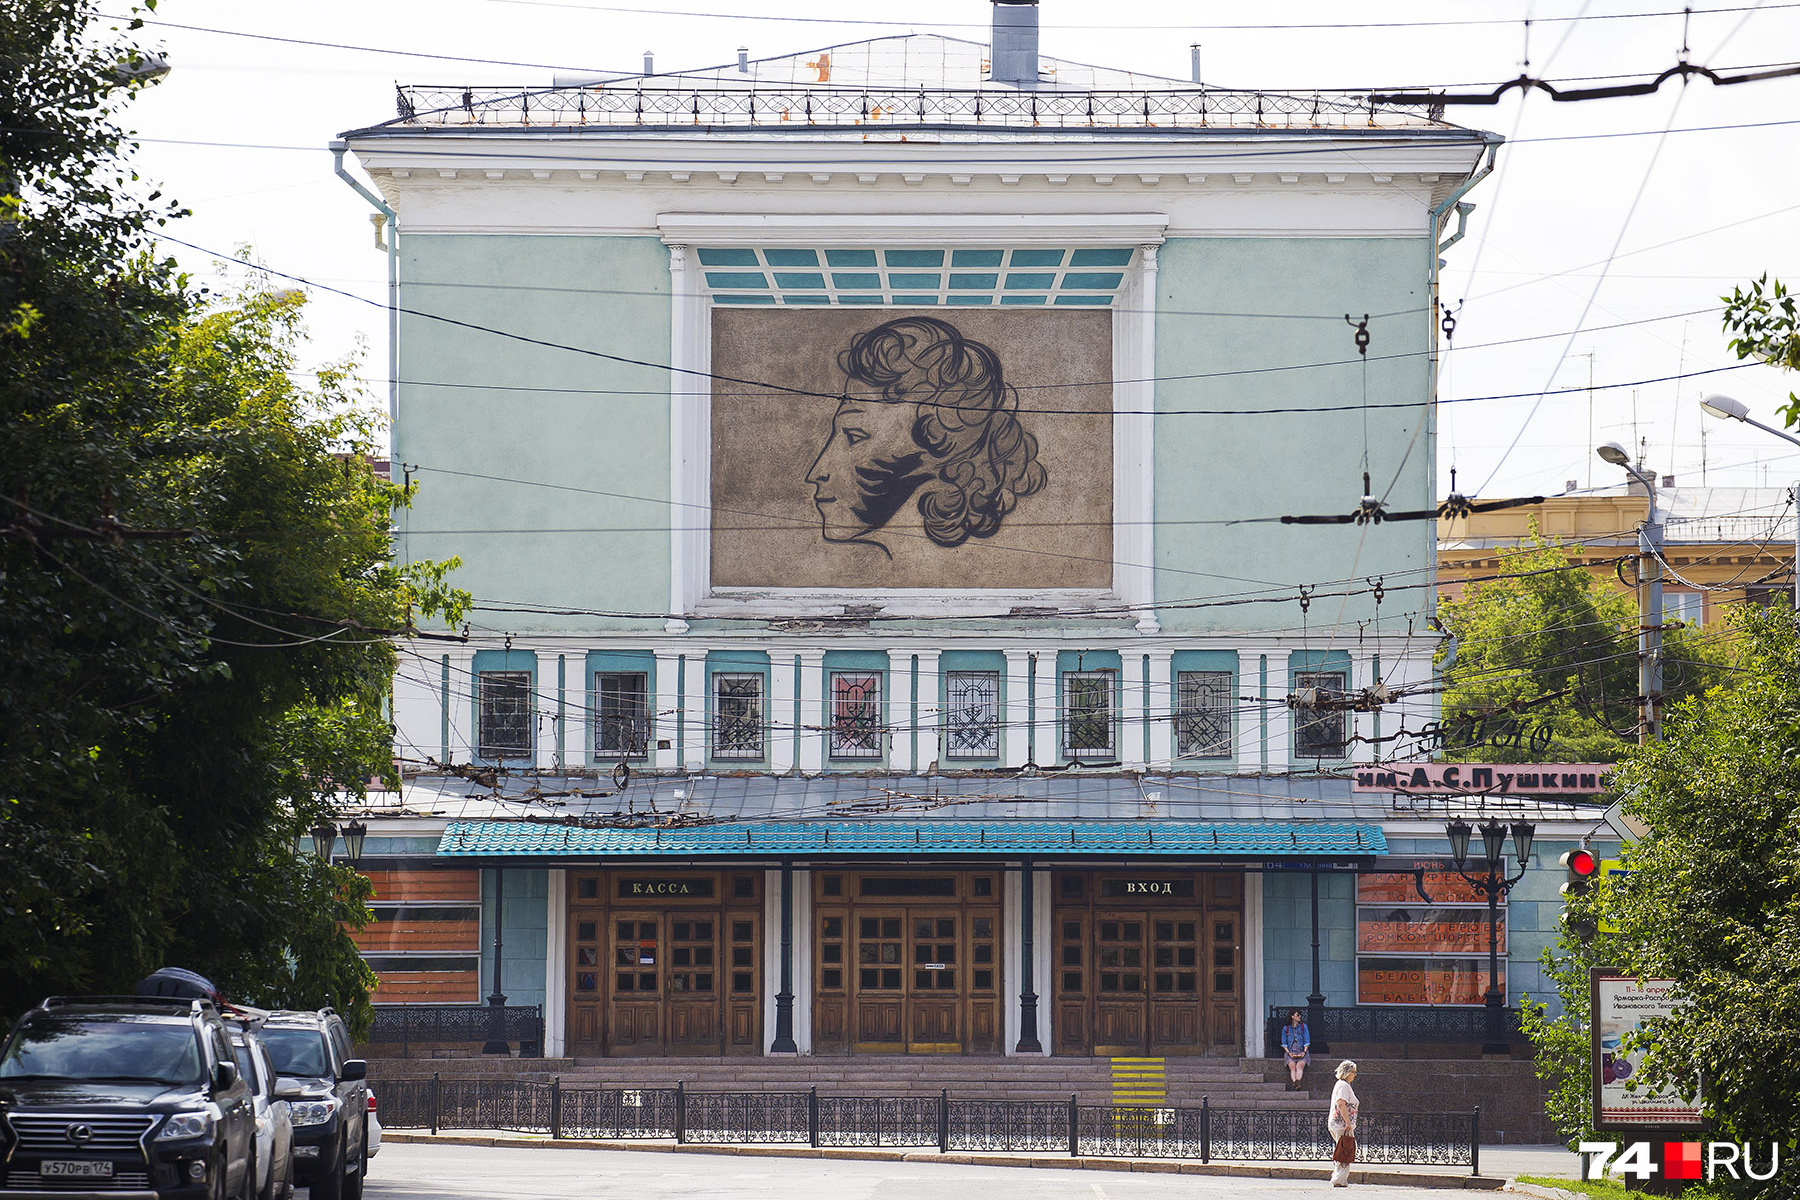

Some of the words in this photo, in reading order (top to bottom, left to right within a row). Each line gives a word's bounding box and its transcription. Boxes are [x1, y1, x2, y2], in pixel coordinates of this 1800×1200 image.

[1413, 861, 1445, 870] ИЮНЬ
[632, 883, 689, 894] КАССА
[1127, 882, 1172, 894] ВХОД
[1371, 923, 1428, 931] ОЗЕРО
[1367, 933, 1426, 942] РОМКОМ
[1375, 973, 1431, 981] БЕЛОЕ
[1443, 973, 1484, 981] ВИНО
[93, 1163, 110, 1172] 174
